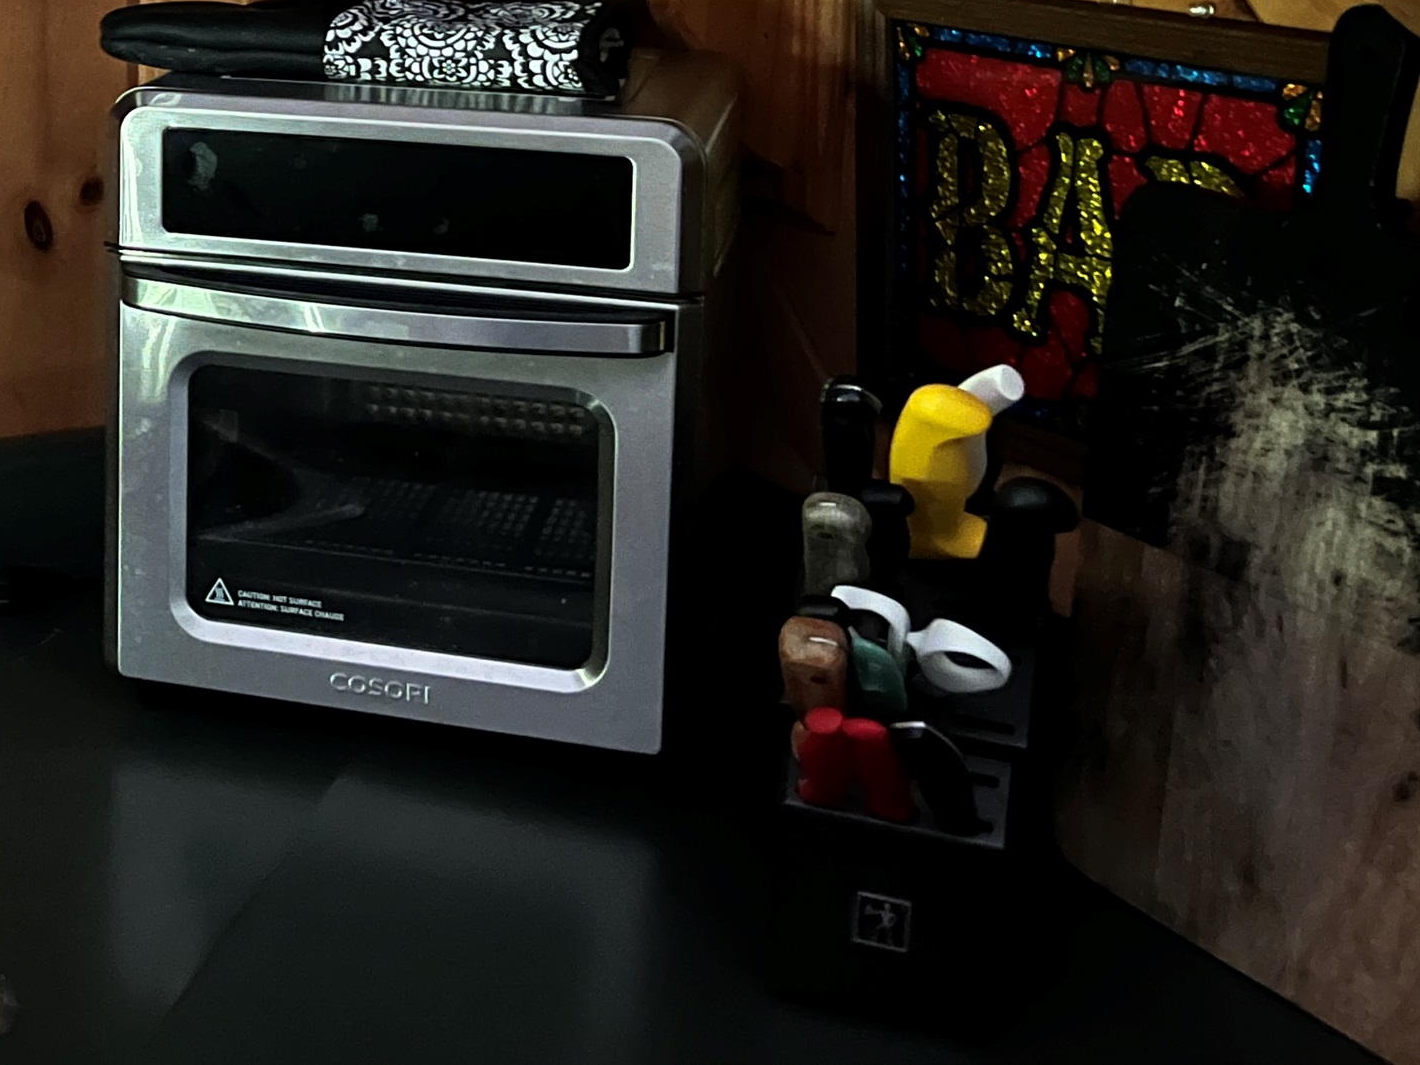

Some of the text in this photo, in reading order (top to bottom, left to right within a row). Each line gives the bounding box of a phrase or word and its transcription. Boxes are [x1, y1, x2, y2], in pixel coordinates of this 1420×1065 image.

[924, 108, 1247, 357] BA
[237, 589, 323, 609] CAUTION: HOT SURFACE
[280, 605, 313, 617] SURFACE
